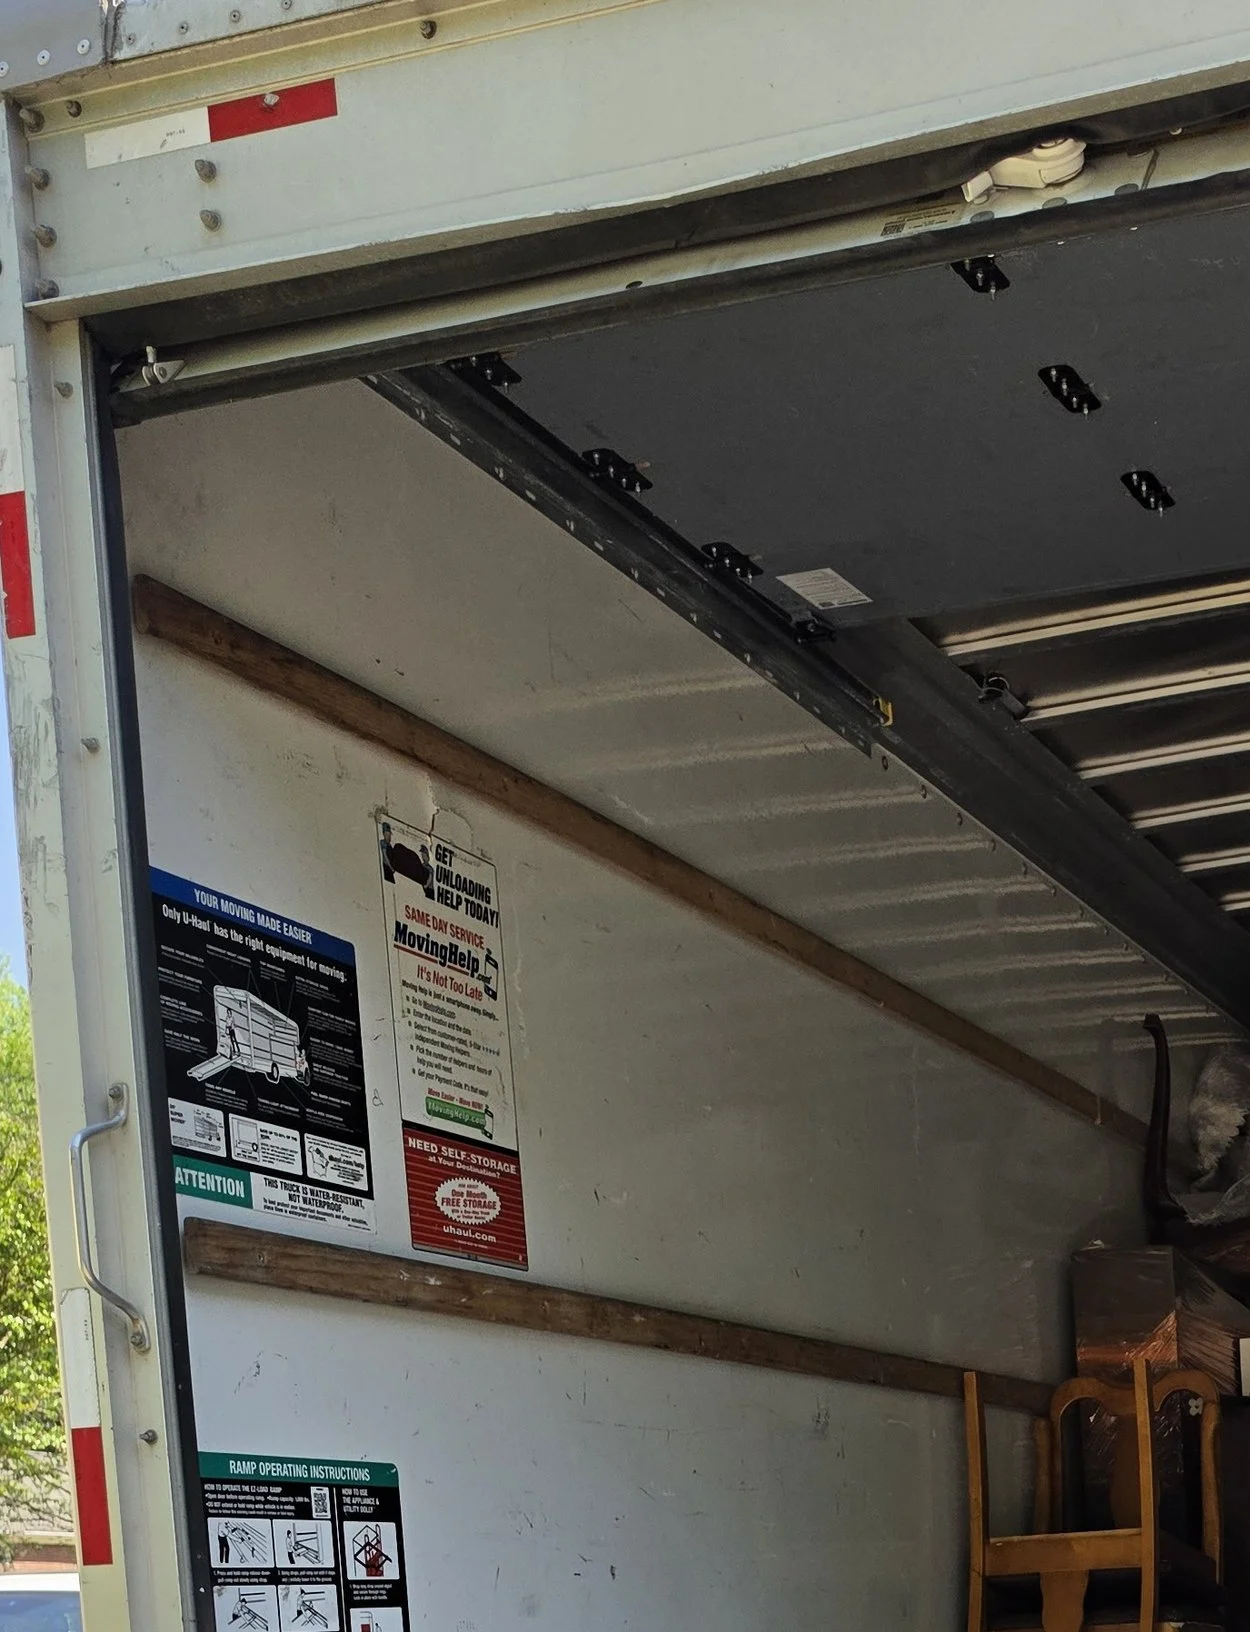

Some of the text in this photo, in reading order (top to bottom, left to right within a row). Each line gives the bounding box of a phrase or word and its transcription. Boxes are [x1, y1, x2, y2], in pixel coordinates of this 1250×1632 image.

[435, 844, 454, 867] GET
[436, 865, 491, 905] UNLOADING
[194, 888, 312, 944] YOUR MOVING MADE EASIER
[437, 885, 499, 928] HELP TODAY!
[162, 904, 181, 924] Only
[213, 923, 229, 939] has
[230, 929, 243, 944] the
[245, 935, 264, 951] right
[266, 943, 305, 967] equipment
[307, 956, 318, 971] for
[405, 904, 485, 950] SAME DAY SERVICE
[417, 964, 483, 1002] It's Not Too Late
[428, 1101, 485, 1125] MovingHelp.com
[408, 1137, 517, 1175] NEED SELF-STORAGE
[437, 1157, 454, 1167] Your
[456, 1161, 500, 1179] Destination?
[175, 1166, 245, 1198] ATTENTION
[263, 1177, 365, 1210] THIS TRUCK IS WATER-RESISTANT,
[451, 1189, 487, 1199] One Month
[288, 1192, 344, 1214] NOT WATERPROOF.
[441, 1197, 497, 1210] FREE STORAGE
[443, 1225, 497, 1243] uhaul.com
[229, 1459, 370, 1482] RAMP OPERATING INSTRUCTIONS
